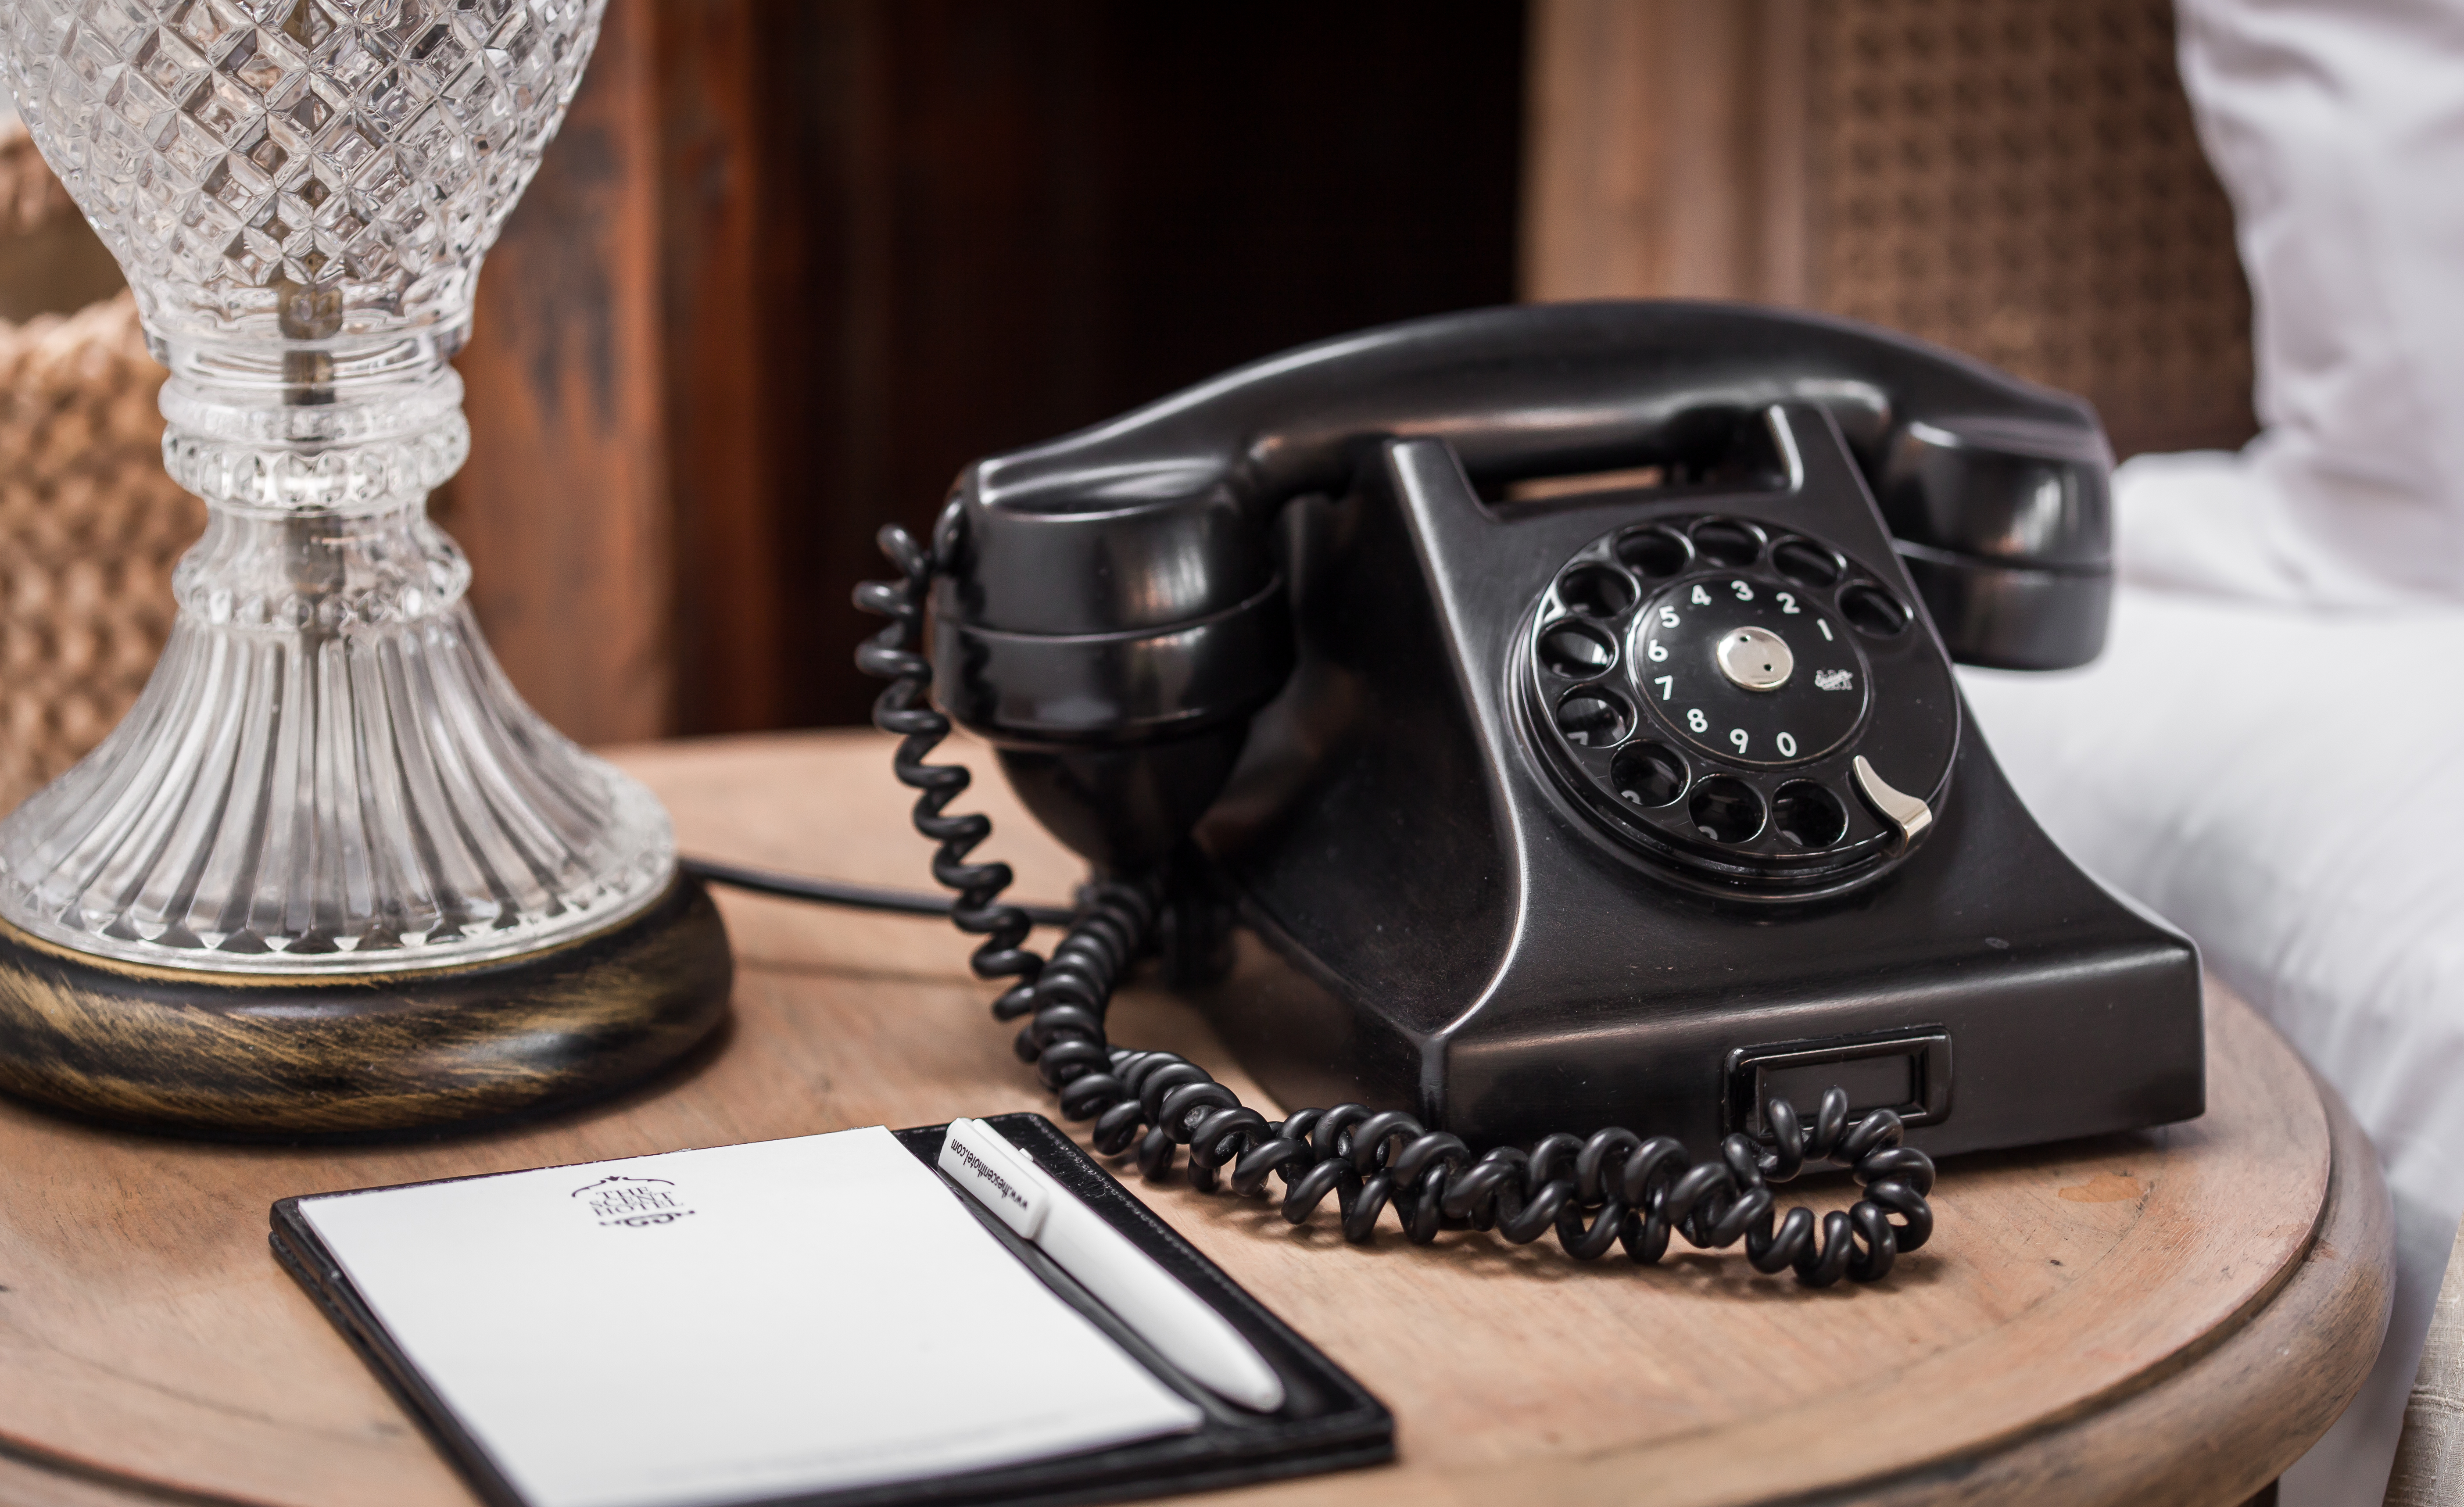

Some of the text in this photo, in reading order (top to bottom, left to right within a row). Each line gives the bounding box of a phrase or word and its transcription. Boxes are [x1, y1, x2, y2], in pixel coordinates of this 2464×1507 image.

[1648, 580, 1833, 757] 1 2 3 4 5 6 7 8 9 0
[950, 1138, 1028, 1212] www.thescenthotel.com
[589, 1191, 671, 1207] SCENT
[595, 1186, 652, 1199] THE
[592, 1199, 684, 1217] HOTEL
